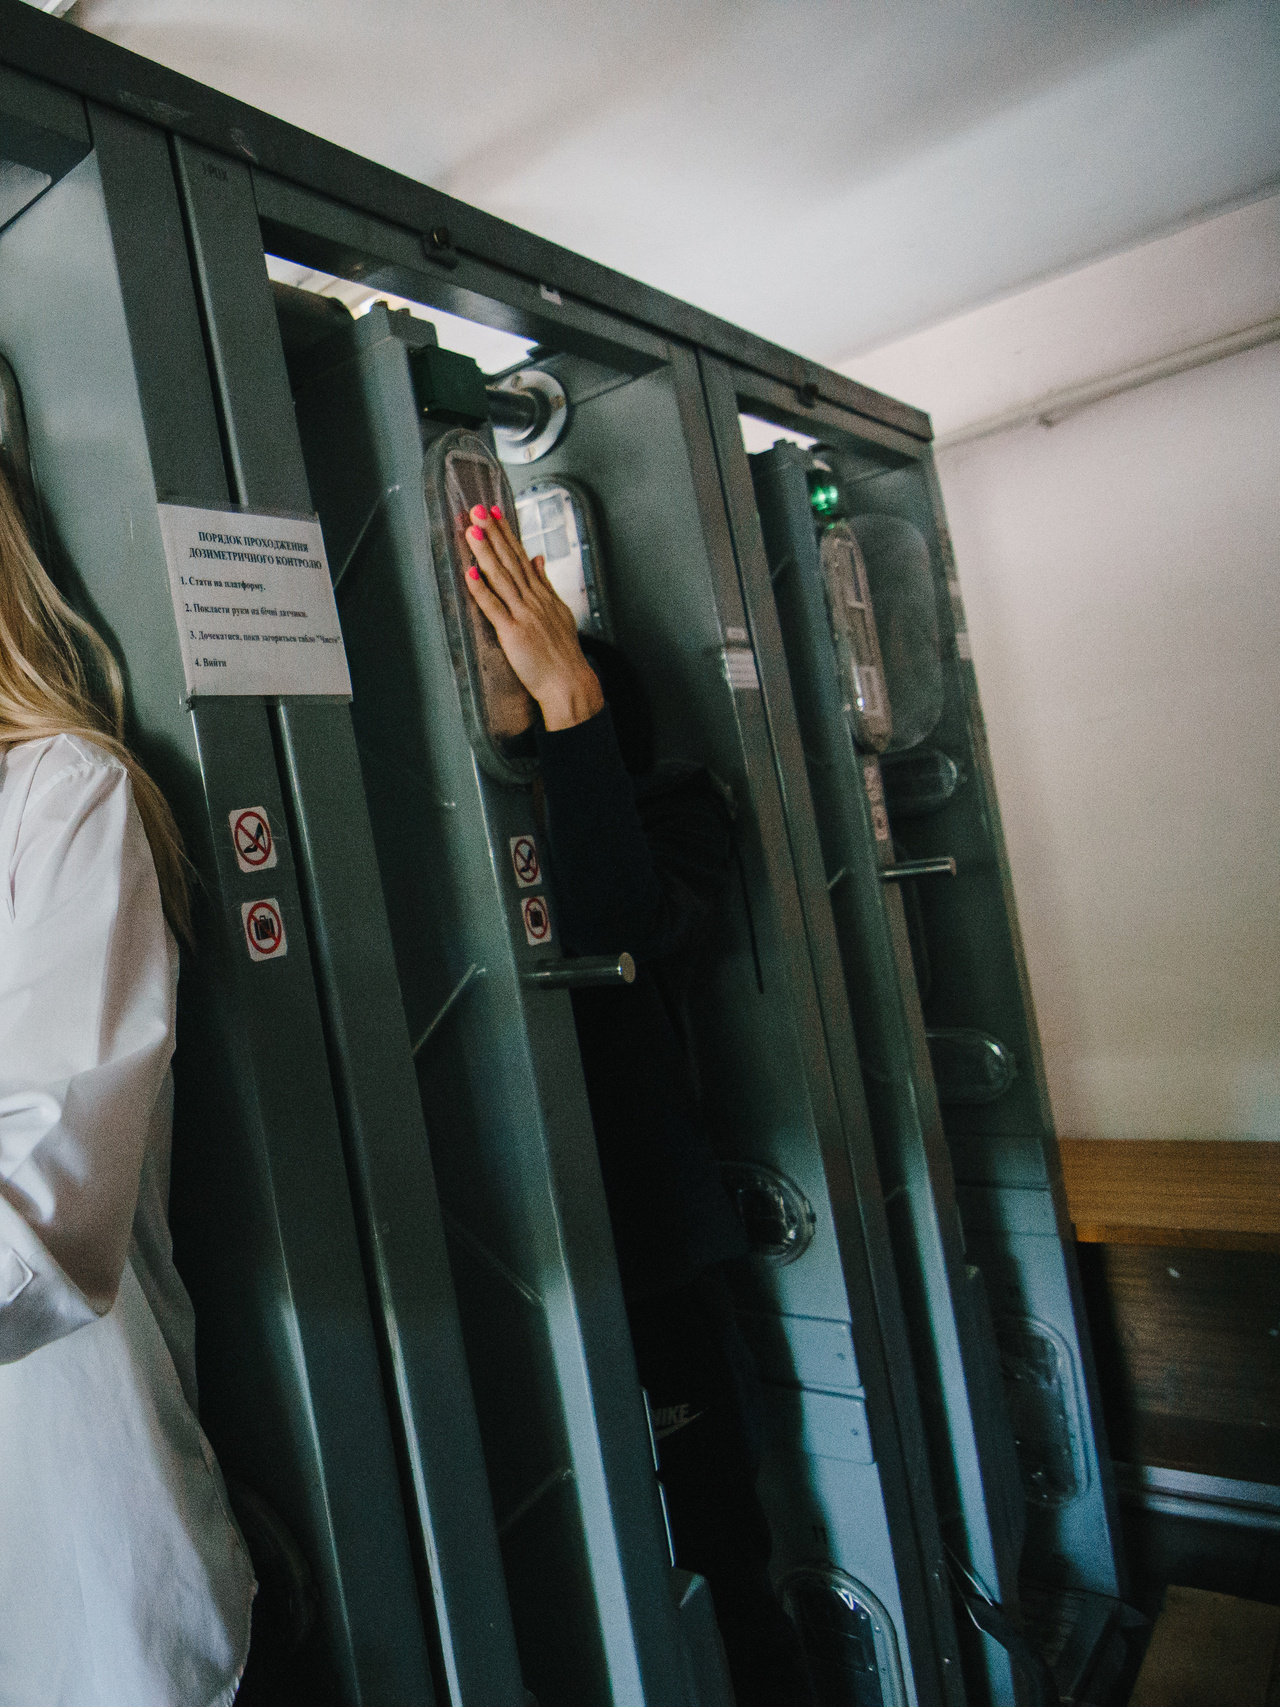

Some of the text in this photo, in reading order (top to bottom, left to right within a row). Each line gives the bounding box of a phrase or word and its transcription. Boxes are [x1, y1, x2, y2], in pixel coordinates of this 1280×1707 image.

[198, 532, 309, 552] ПОРЯДОК ПРОХОДЖЕННЯ
[189, 548, 322, 569] ДОЗИМЕТРИЧНОГО КОНТРОЛЮ
[181, 576, 188, 585] 1.
[188, 576, 213, 587] Стати
[224, 580, 266, 592] платформу.
[185, 603, 192, 612] 2.
[193, 603, 230, 614] Покласти
[232, 607, 249, 617] руки
[251, 608, 259, 616] на
[190, 630, 197, 640] 3.
[198, 630, 242, 642] Дочекатися,
[243, 634, 260, 642] поки
[195, 657, 227, 667] 4. Вийти
